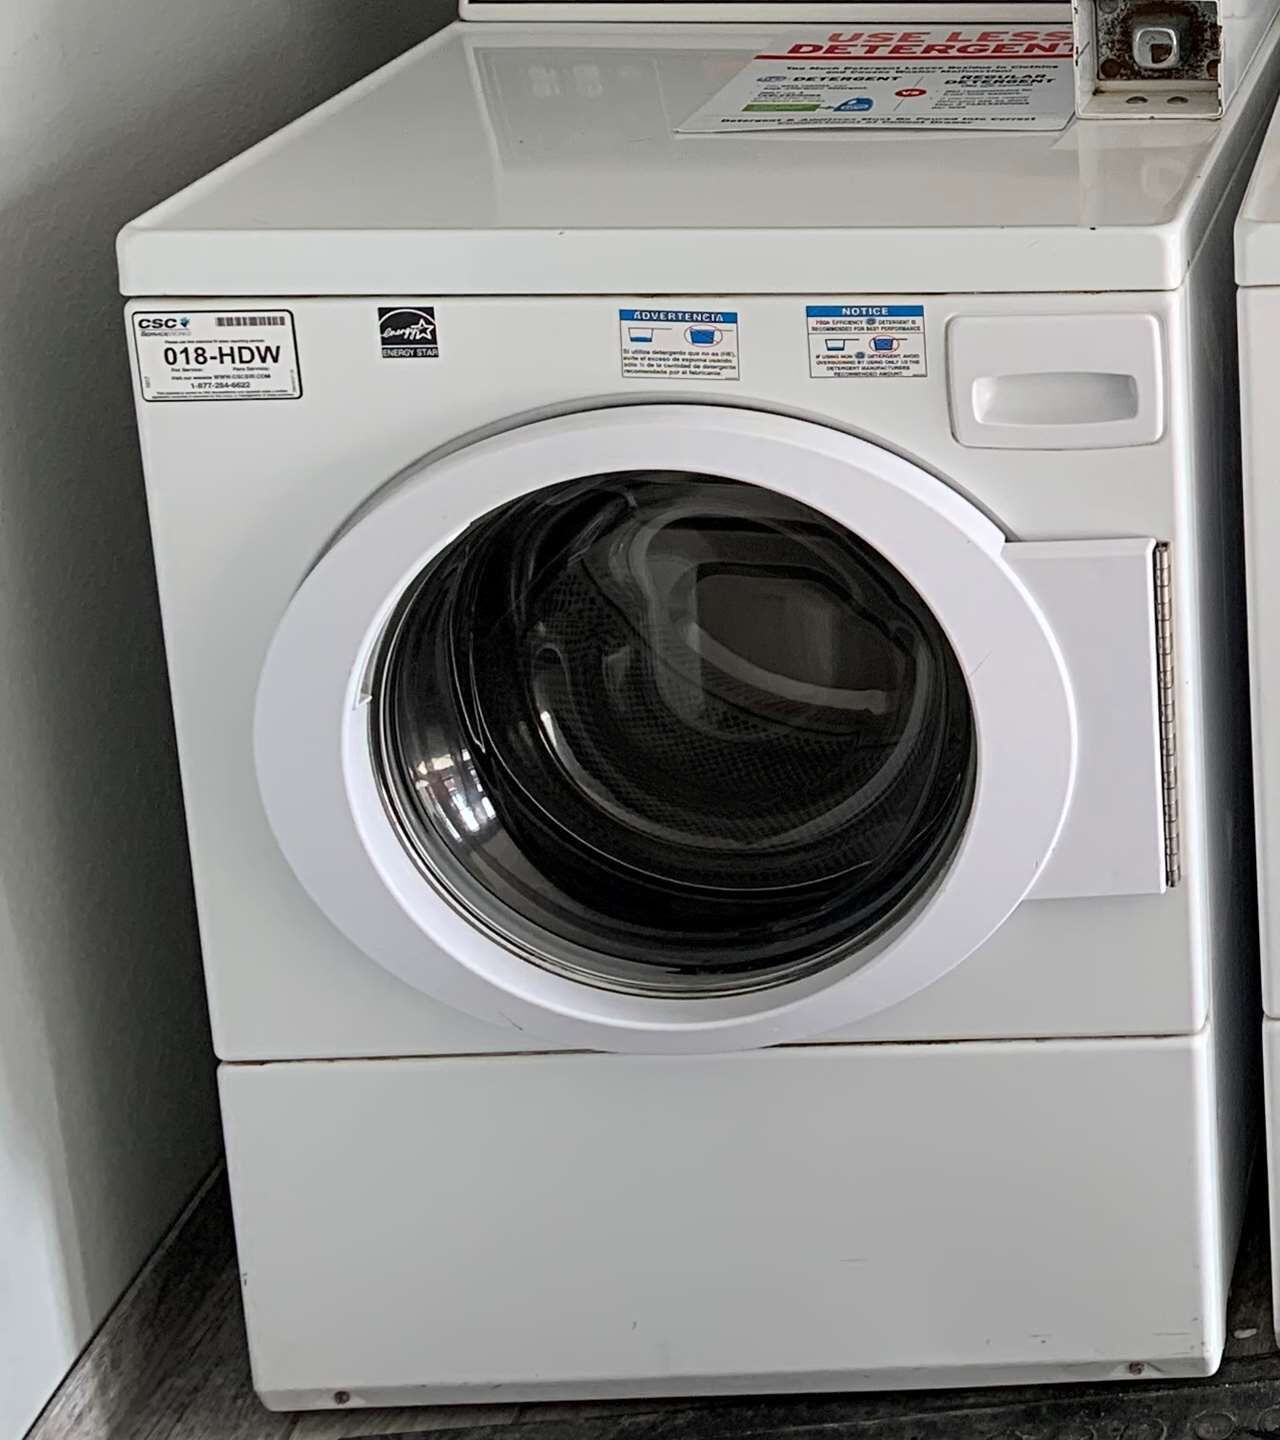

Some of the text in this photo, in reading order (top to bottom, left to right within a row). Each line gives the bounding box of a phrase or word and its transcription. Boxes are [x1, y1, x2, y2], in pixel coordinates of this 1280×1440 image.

[827, 31, 1073, 43] USE LESS
[633, 311, 724, 322] ADVERTENCIA
[841, 307, 889, 316] NOTICE
[138, 318, 177, 329] CSC
[163, 345, 281, 365] 018-HDW
